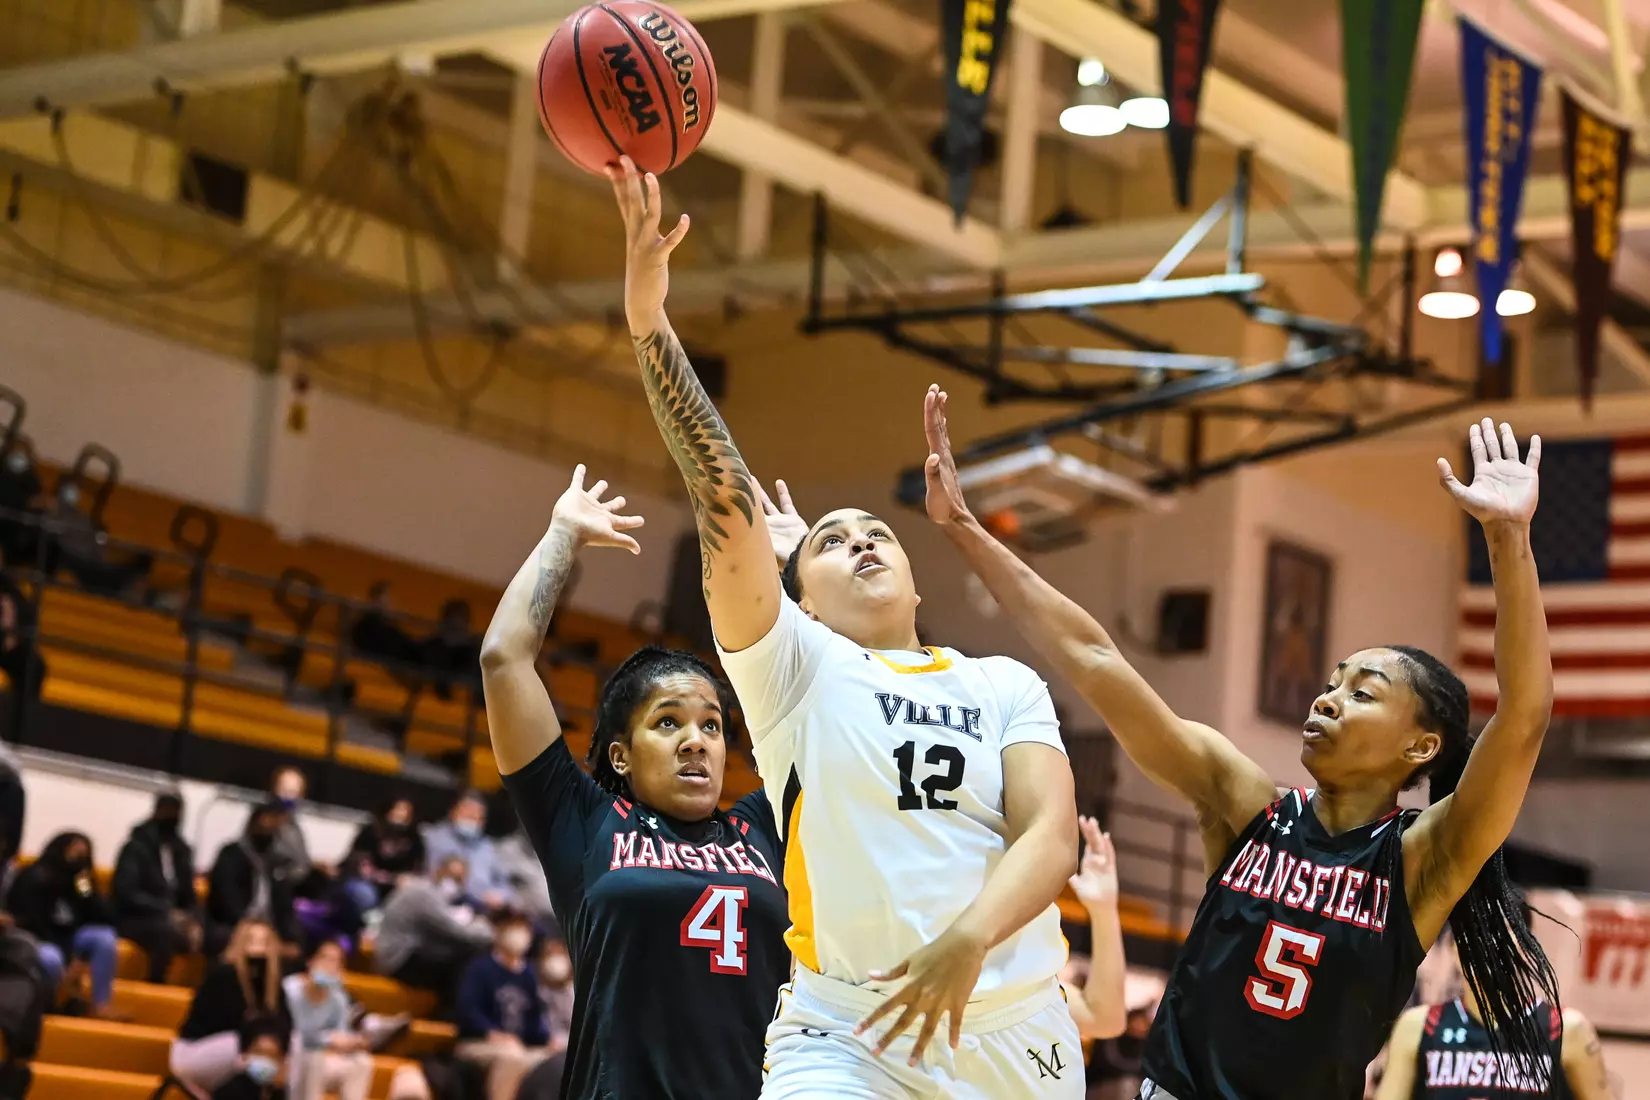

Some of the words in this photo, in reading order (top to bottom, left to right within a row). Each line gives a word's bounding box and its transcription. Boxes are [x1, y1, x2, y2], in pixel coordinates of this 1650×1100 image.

[603, 42, 662, 135] NCAA
[638, 11, 701, 135] Wilson
[875, 692, 982, 743] VILLE
[893, 740, 966, 811] 12
[680, 884, 749, 976] 4
[1243, 919, 1327, 1021] 5
